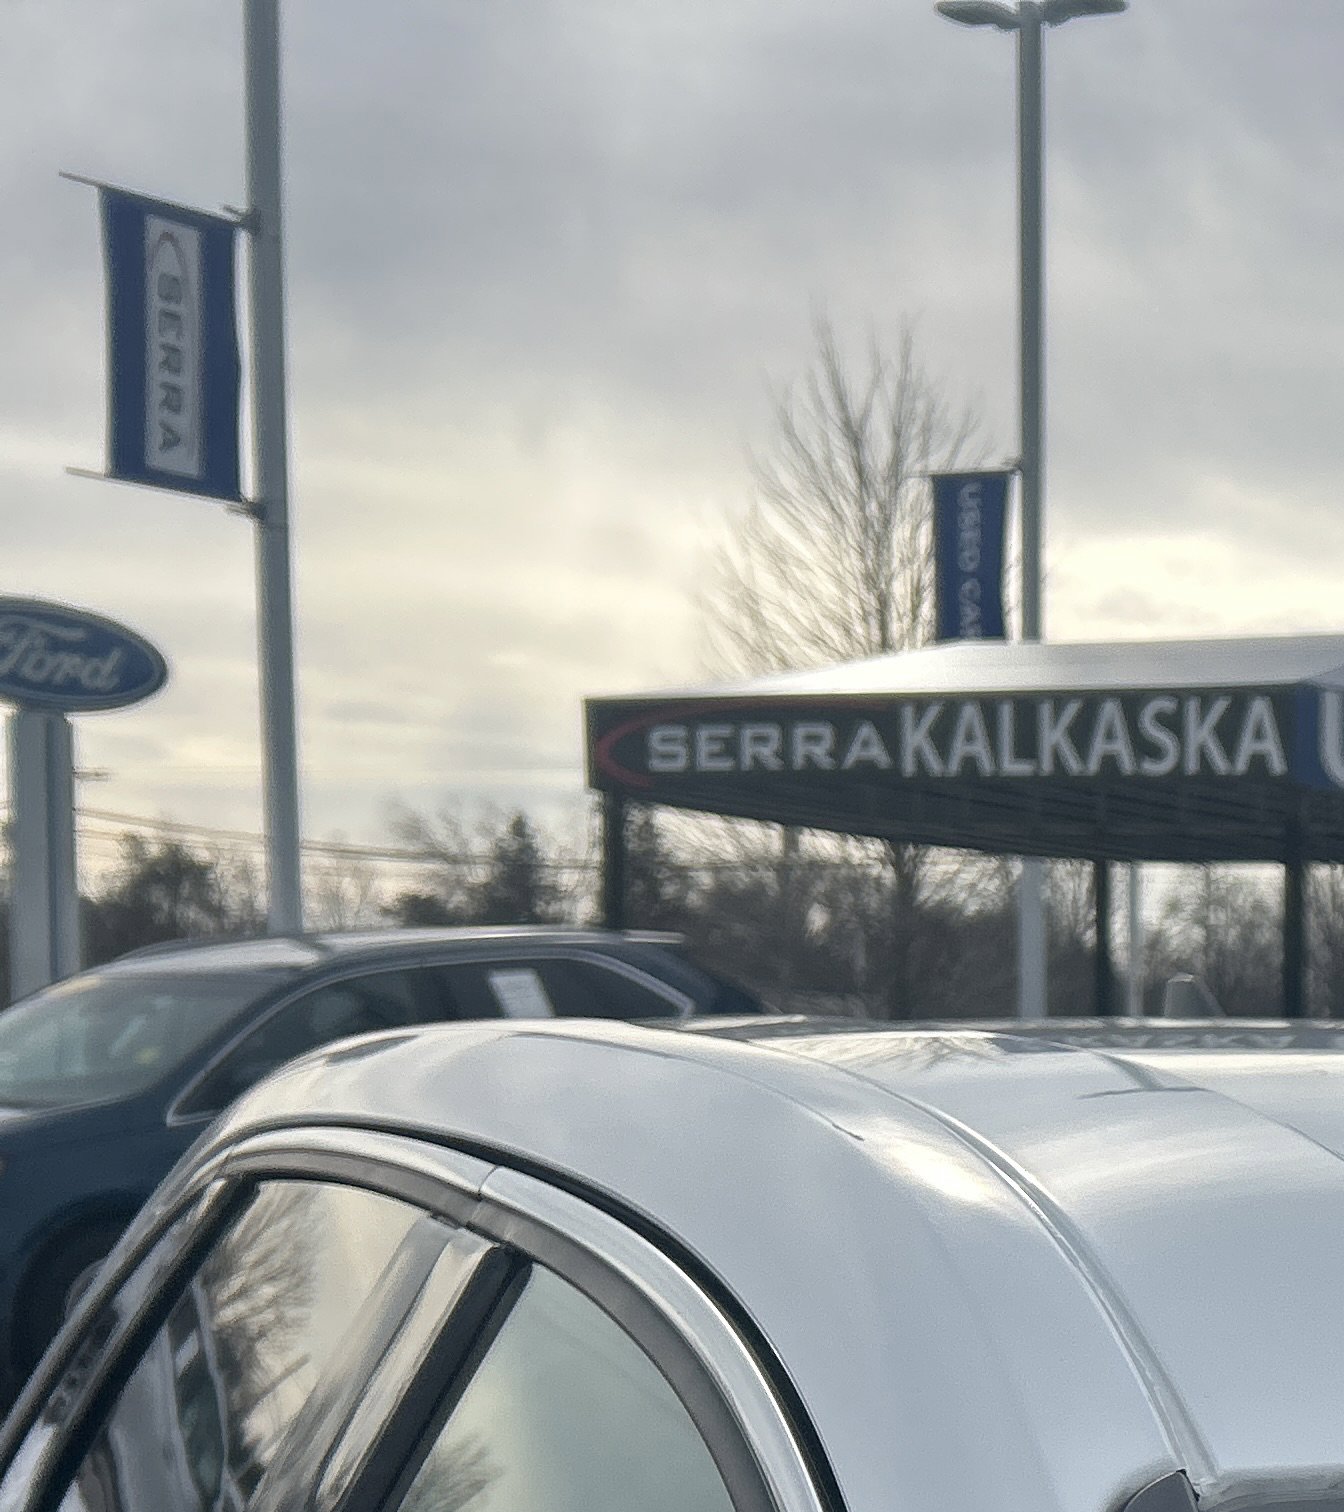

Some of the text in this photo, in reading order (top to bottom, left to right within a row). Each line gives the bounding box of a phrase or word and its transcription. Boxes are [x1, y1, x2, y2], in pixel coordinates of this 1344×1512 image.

[157, 271, 183, 453] SERRA
[646, 696, 1289, 778] SERRA KALKASKA
